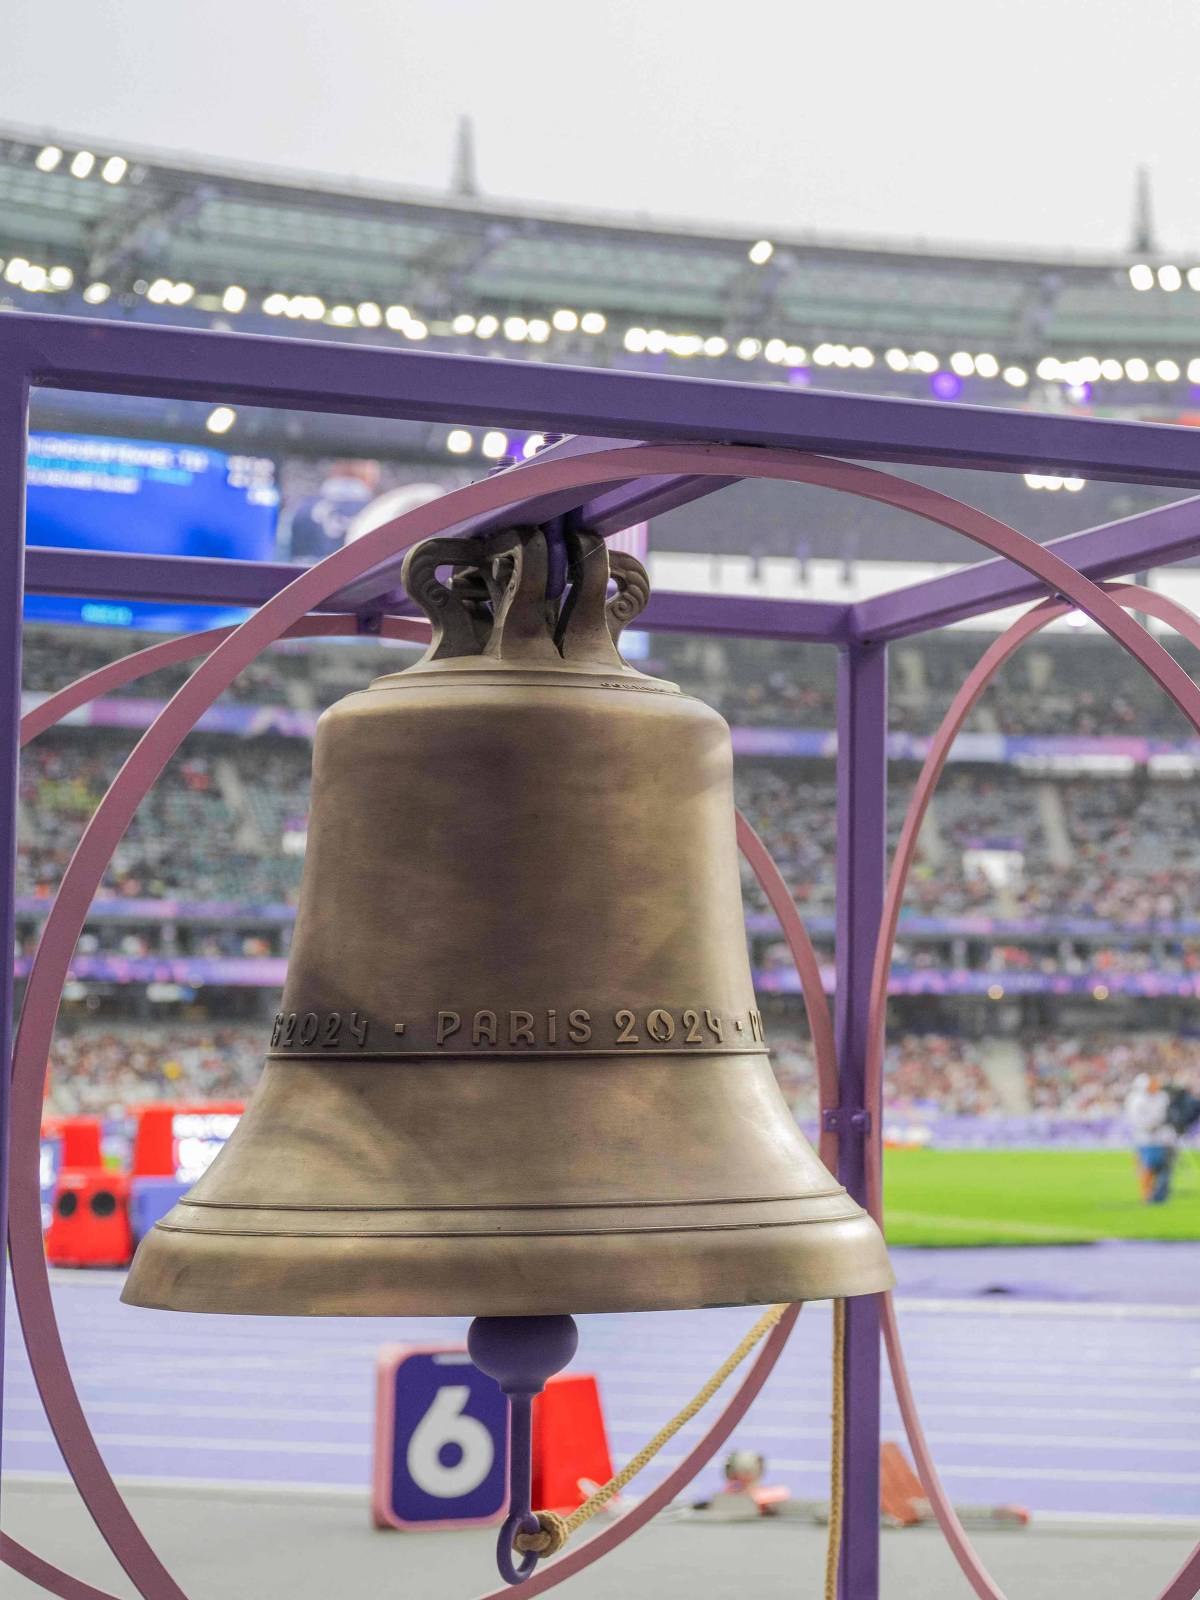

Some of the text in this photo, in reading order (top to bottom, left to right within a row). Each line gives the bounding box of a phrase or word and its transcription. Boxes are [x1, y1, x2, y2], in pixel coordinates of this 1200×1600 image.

[282, 1012, 368, 1048] 2024
[615, 1009, 724, 1043] 2024
[406, 1385, 494, 1498] 6
